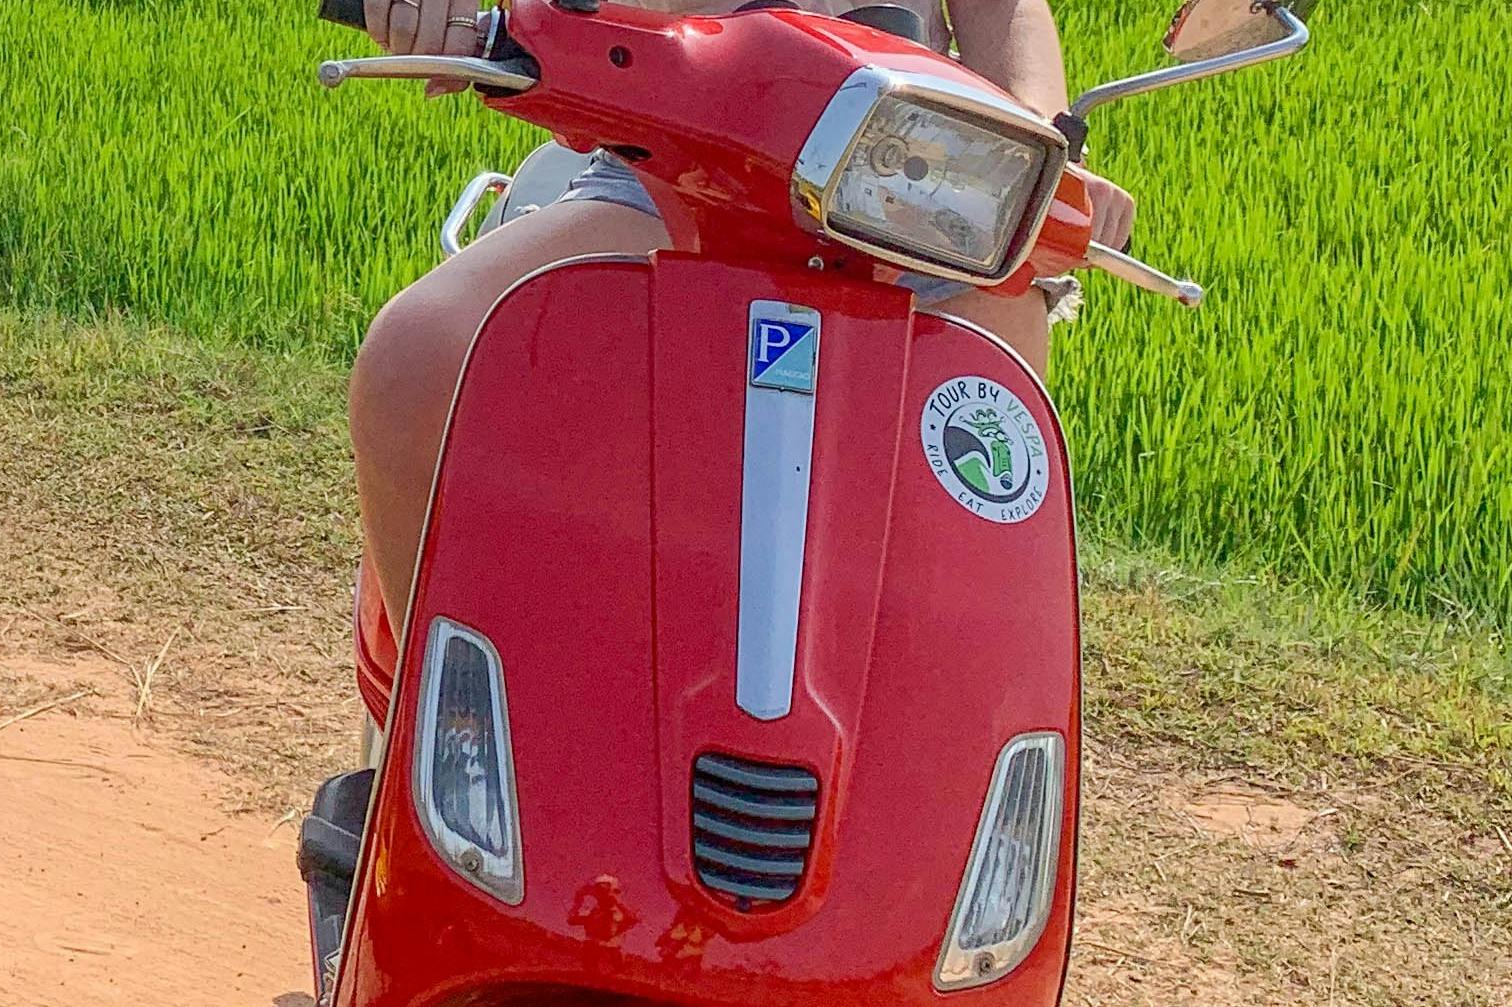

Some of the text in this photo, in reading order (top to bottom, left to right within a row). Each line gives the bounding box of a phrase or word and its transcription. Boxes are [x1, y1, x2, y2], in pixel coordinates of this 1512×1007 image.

[757, 323, 791, 363] P
[929, 381, 1043, 458] TOUR BY VESPA
[928, 444, 1042, 521] RIDE EAT EXPLORE
